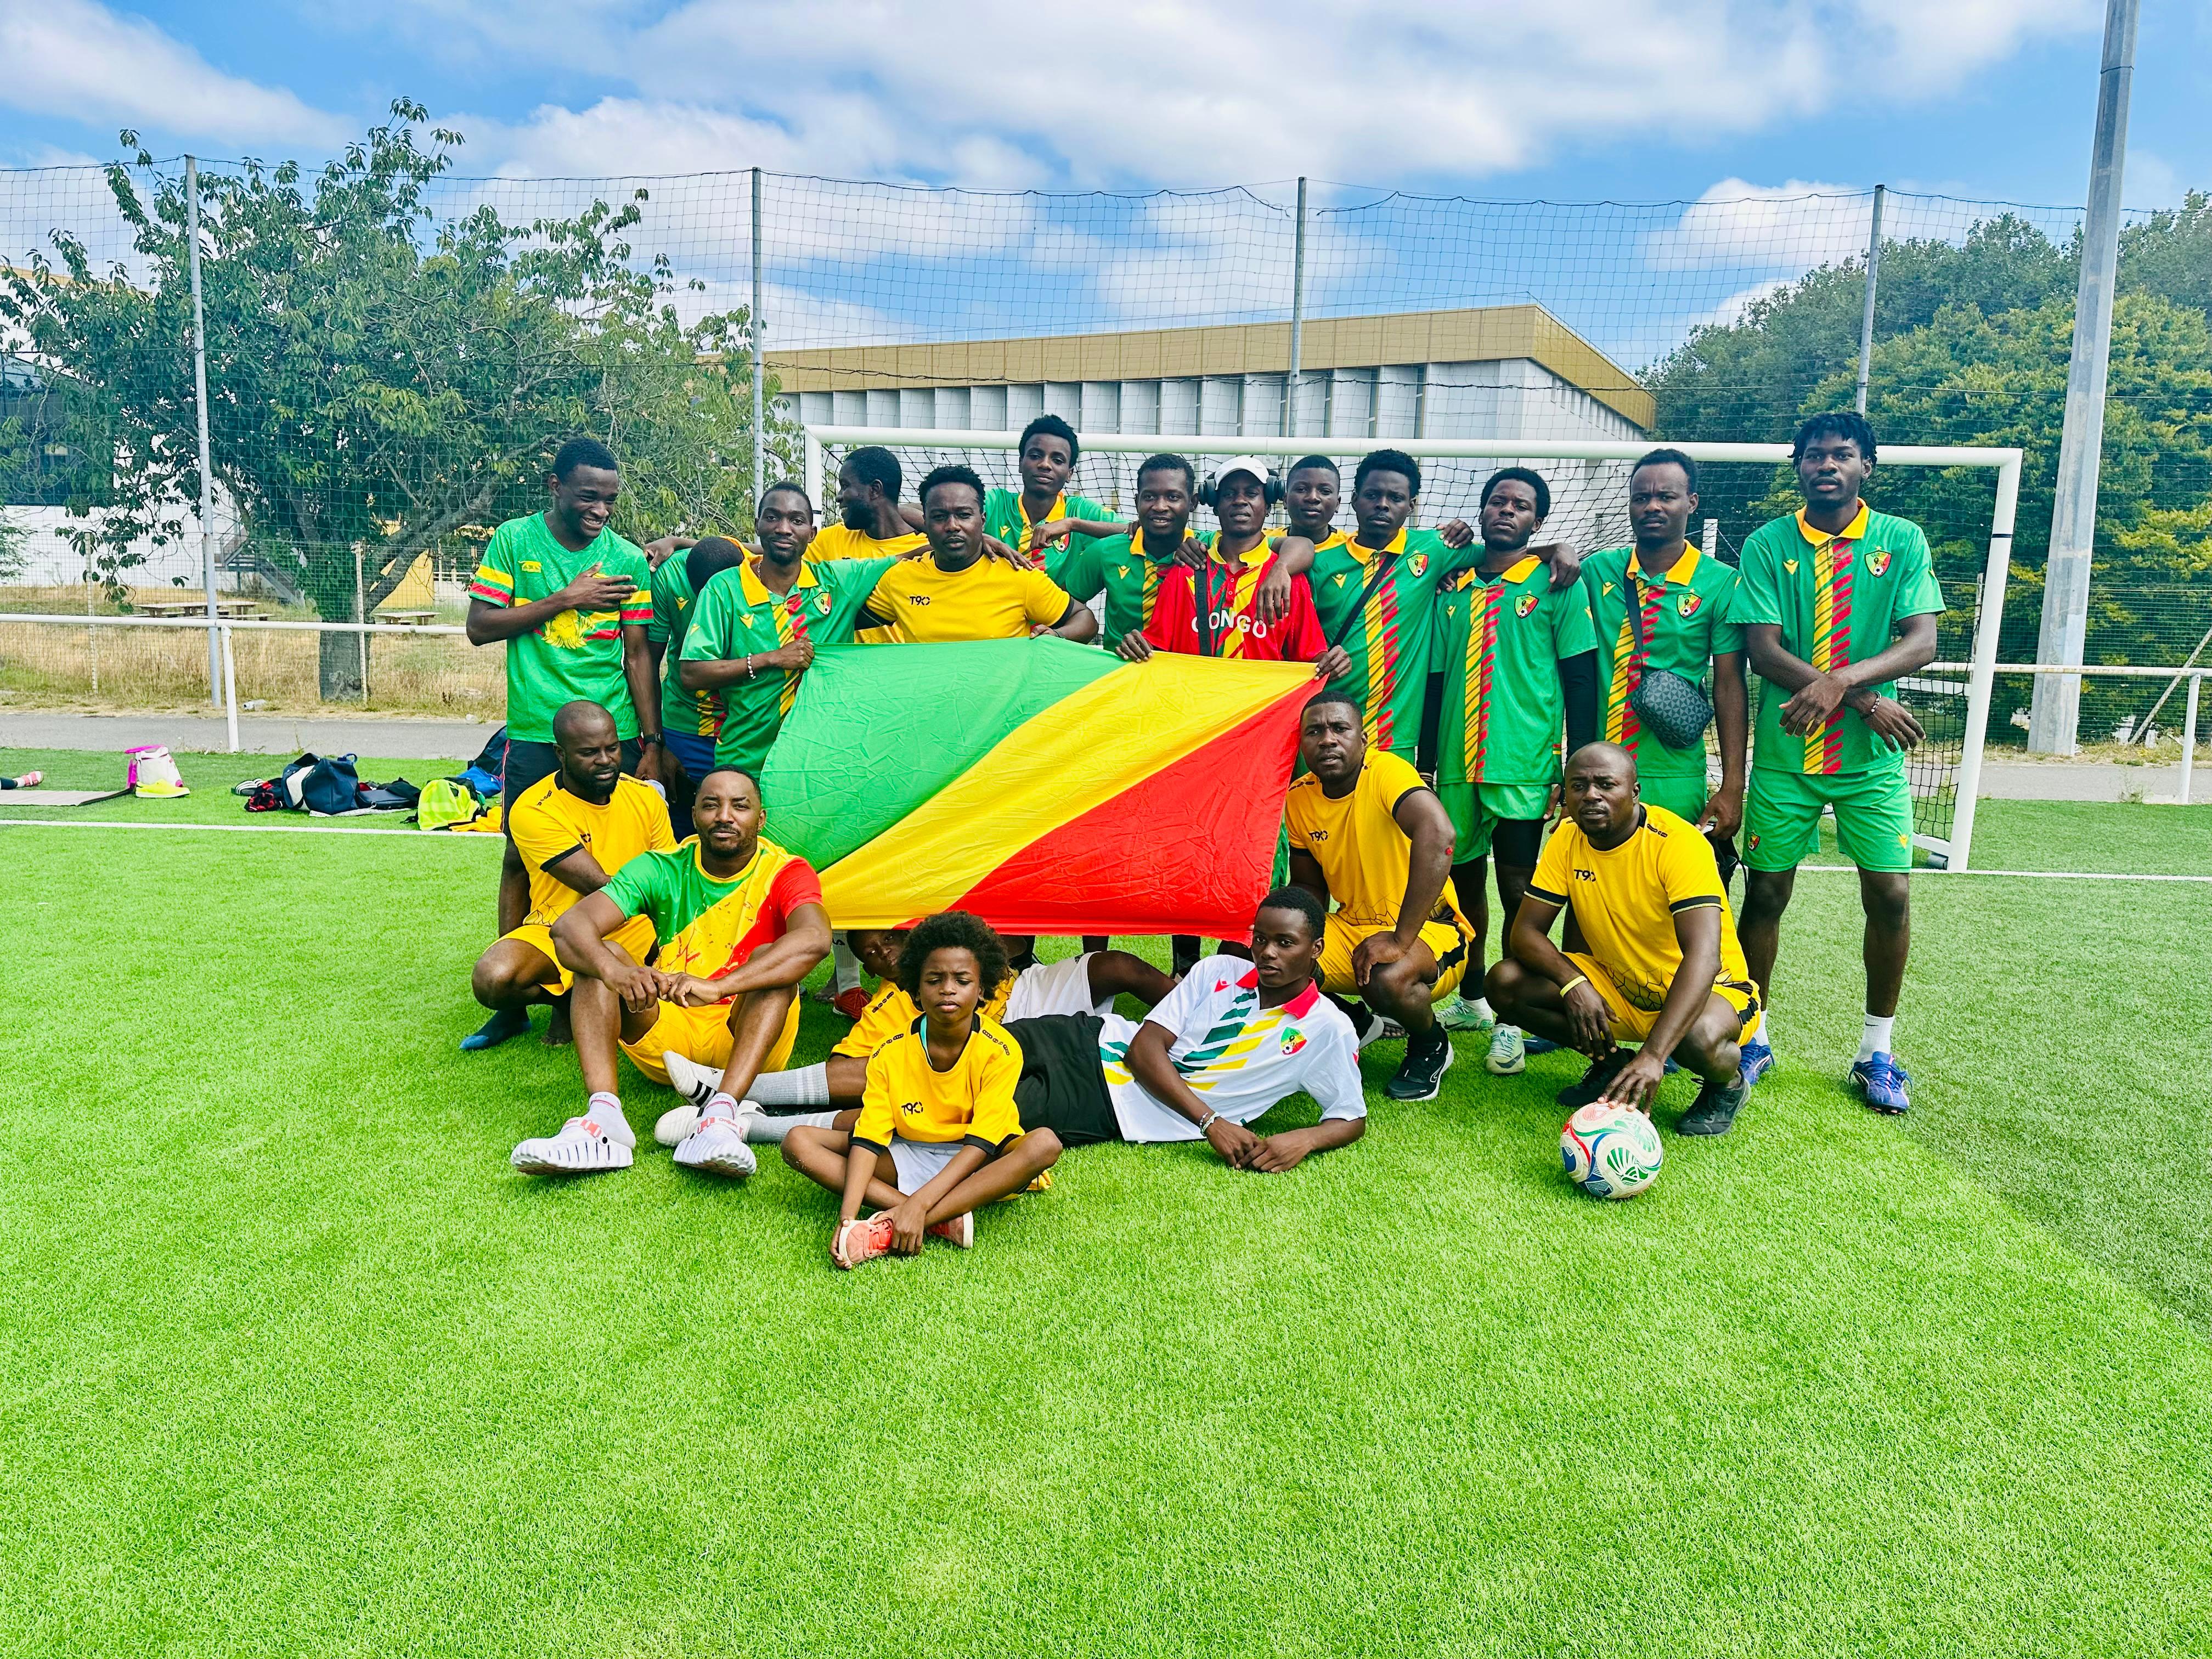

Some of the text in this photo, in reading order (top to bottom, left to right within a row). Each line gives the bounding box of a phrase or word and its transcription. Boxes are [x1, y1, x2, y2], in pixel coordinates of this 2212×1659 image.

[909, 596, 930, 606] T90
[1308, 830, 1328, 842] T90
[901, 1102, 923, 1116] T90
